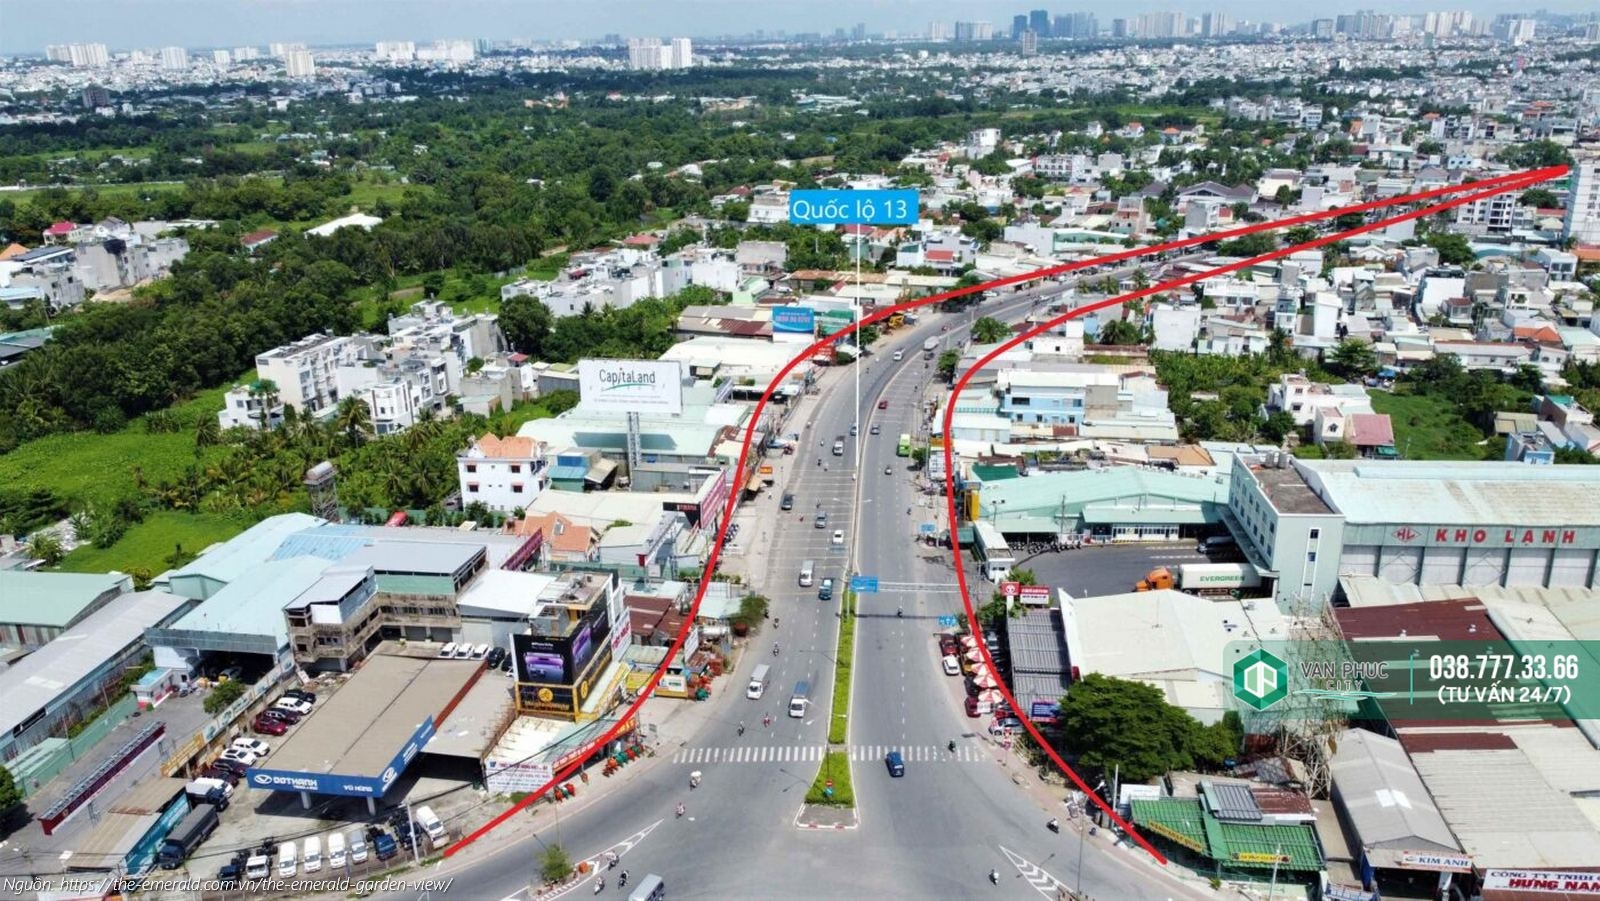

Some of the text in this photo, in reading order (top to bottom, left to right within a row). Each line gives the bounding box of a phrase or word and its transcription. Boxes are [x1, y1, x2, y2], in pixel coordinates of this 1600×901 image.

[599, 367, 656, 385] CapitaLand
[1435, 529, 1487, 543] KHO
[1504, 530, 1576, 547] LẠNH
[1200, 575, 1246, 583] EVERGREEN
[1443, 858, 1469, 867] ANH
[1532, 872, 1551, 880] TY
